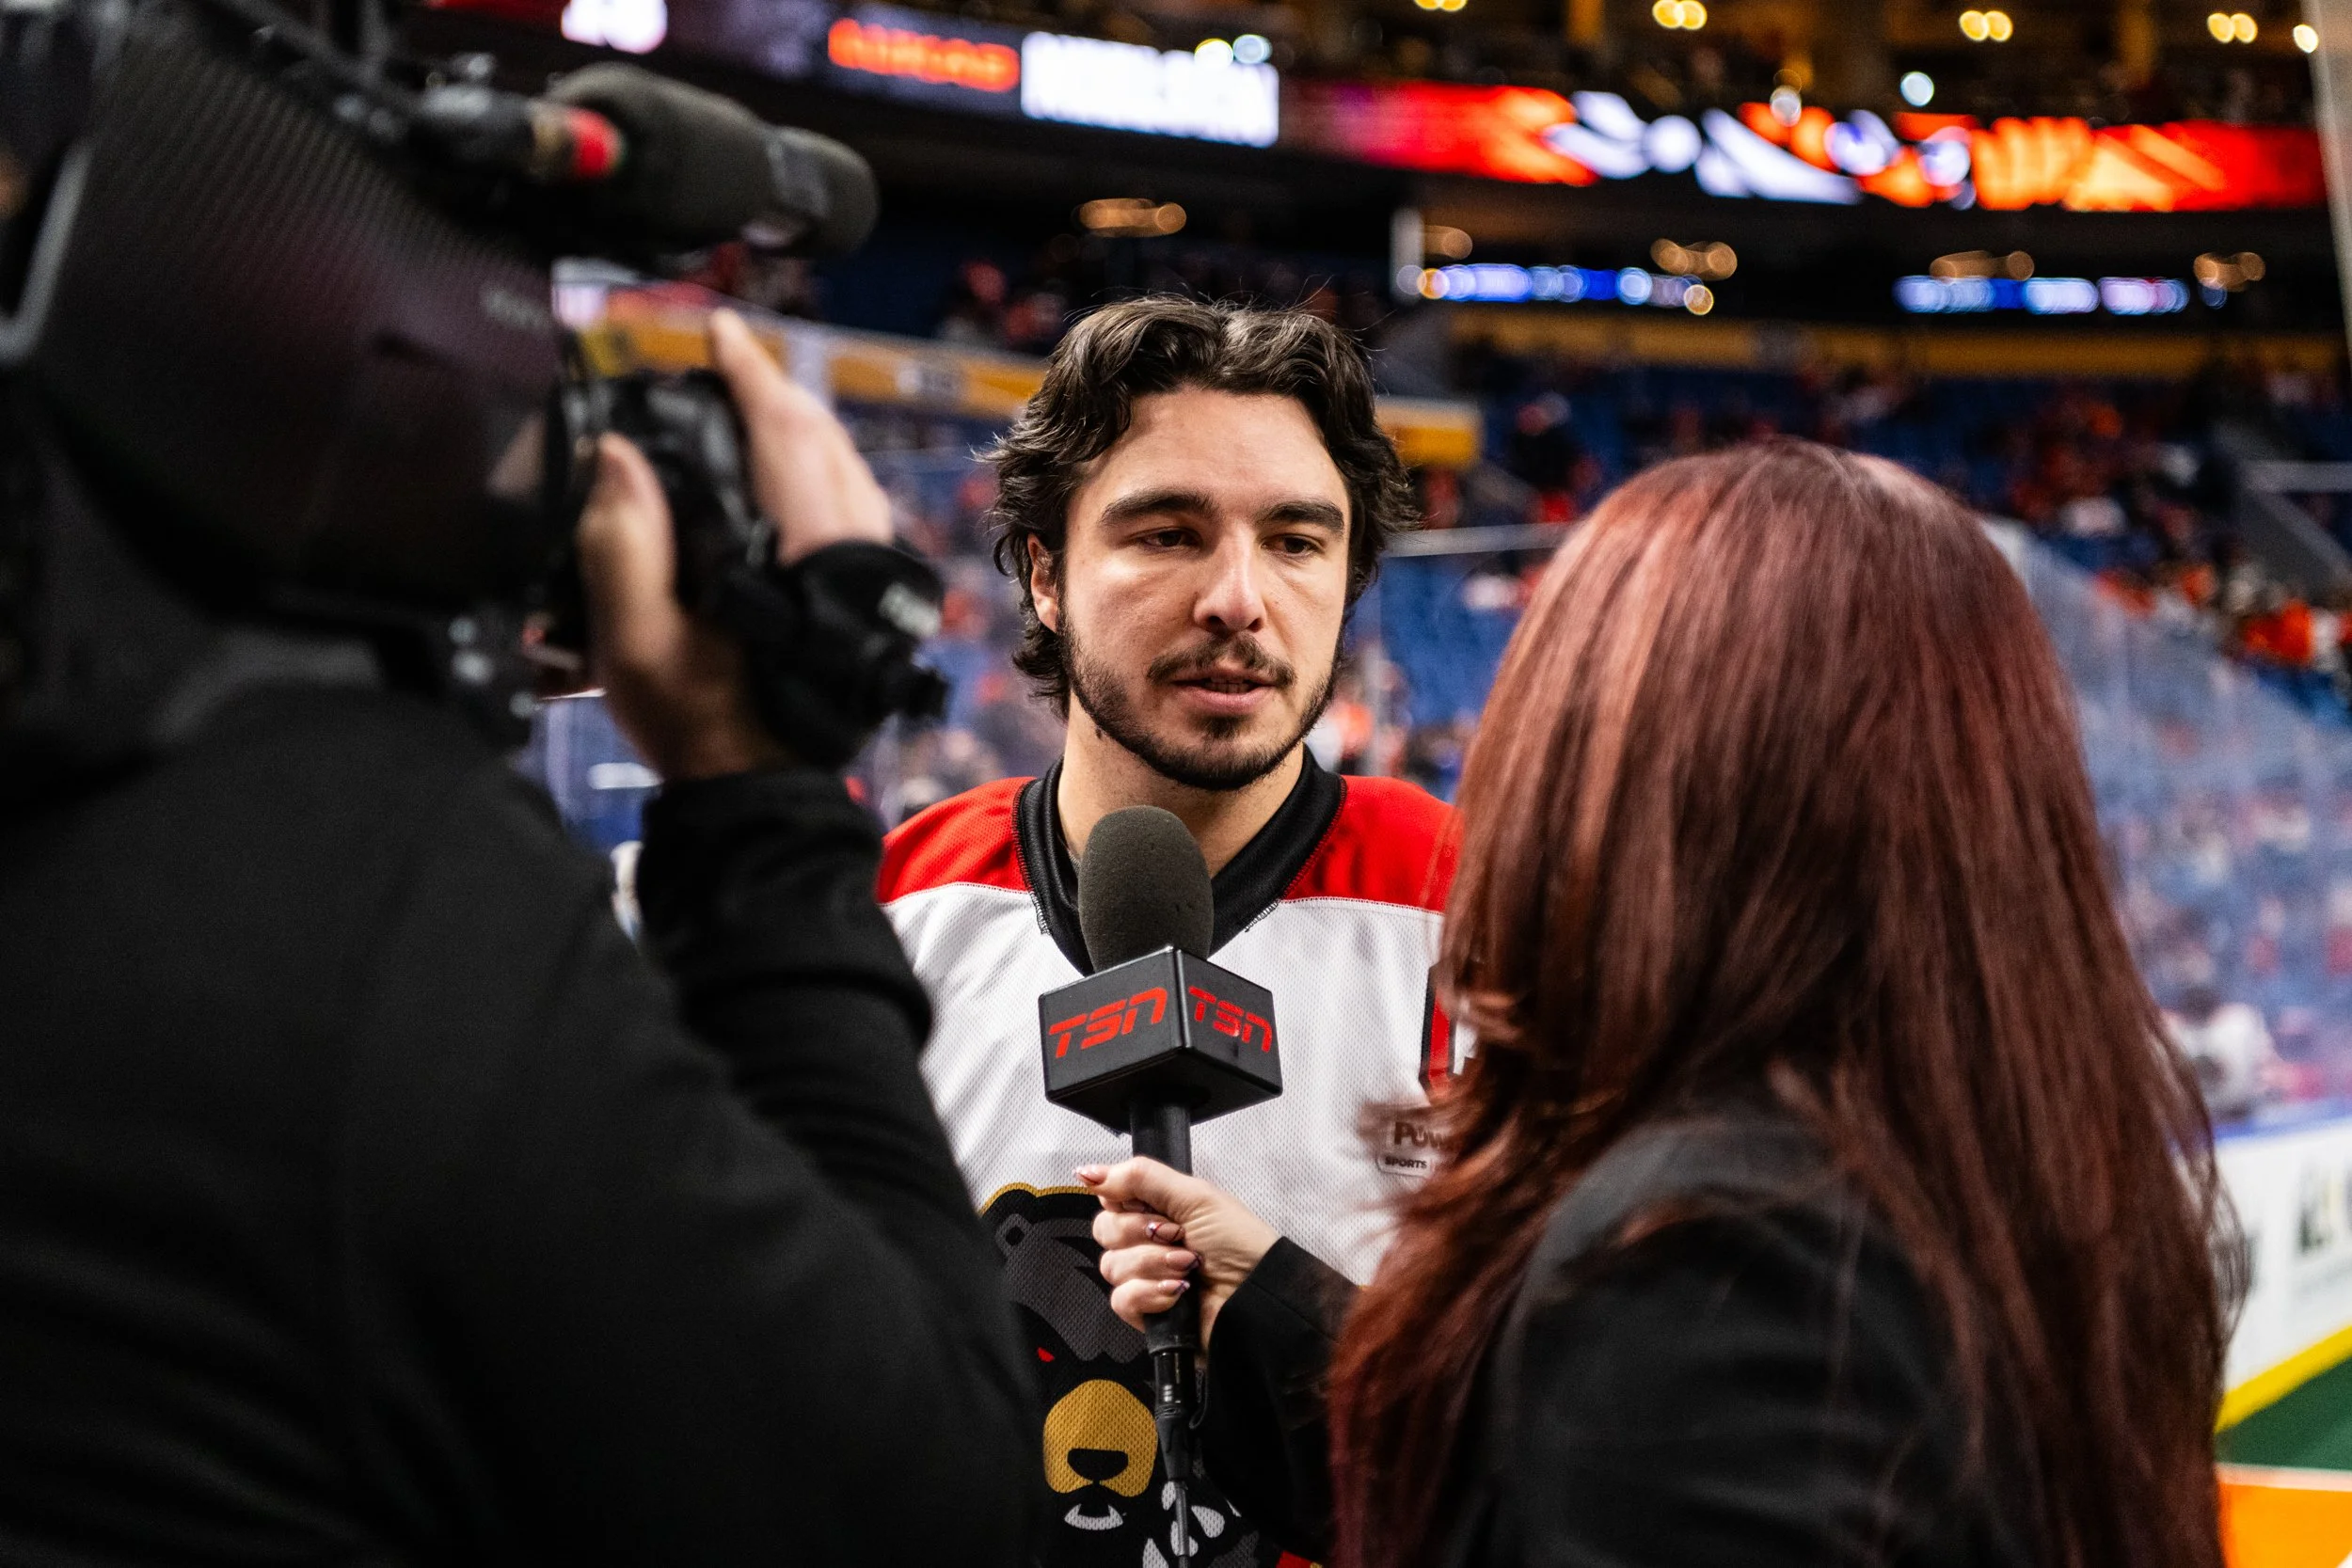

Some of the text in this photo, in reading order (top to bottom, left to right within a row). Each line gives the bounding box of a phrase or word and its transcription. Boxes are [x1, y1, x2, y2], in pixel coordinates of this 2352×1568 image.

[1048, 986, 1168, 1059] TSN
[1188, 985, 1273, 1053] TSN
[1384, 1155, 1427, 1169] SPORTS
